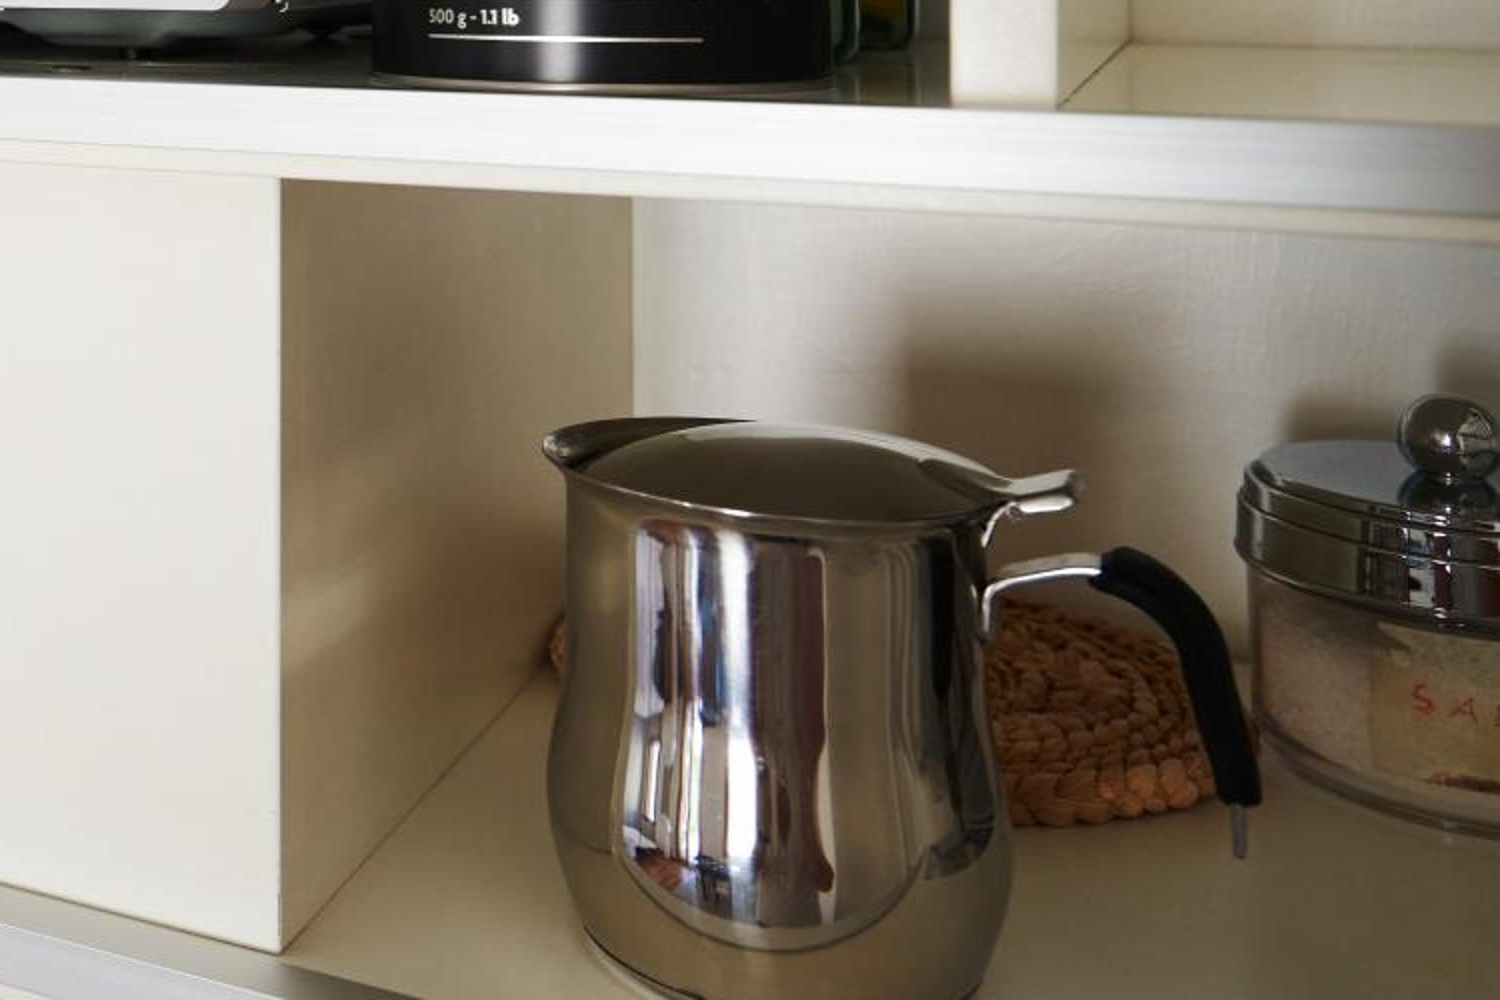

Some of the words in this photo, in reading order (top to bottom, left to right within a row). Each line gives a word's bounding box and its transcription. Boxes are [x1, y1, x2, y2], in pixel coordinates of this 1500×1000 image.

[429, 8, 455, 24] 500
[457, 12, 467, 30] g
[480, 9, 498, 25] 1.1
[501, 7, 521, 27] lb
